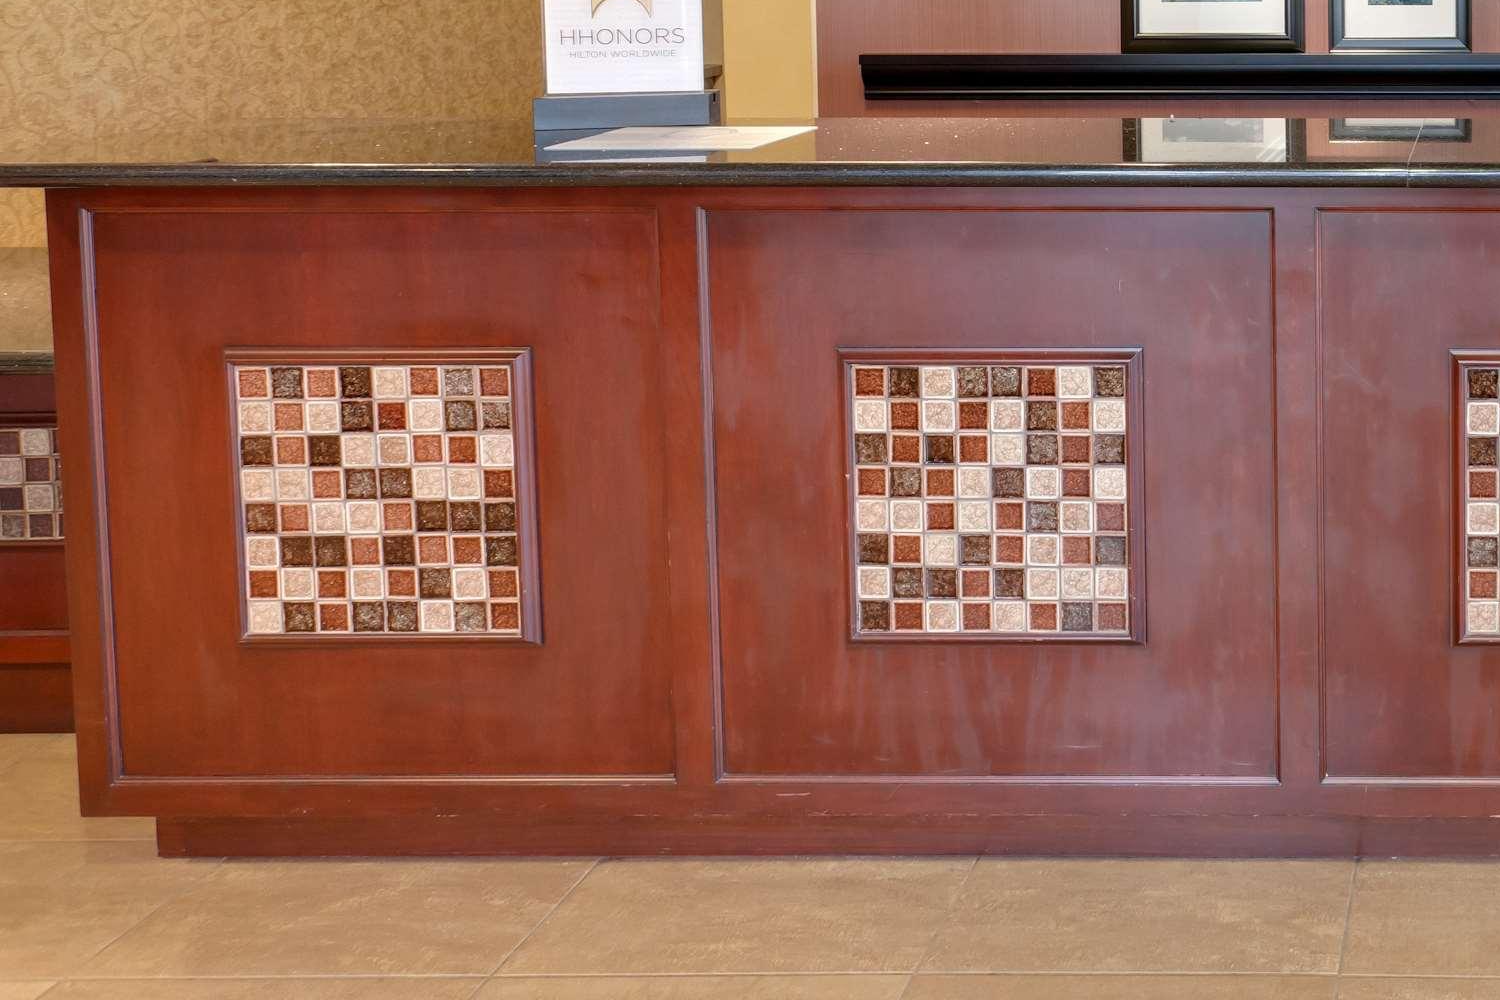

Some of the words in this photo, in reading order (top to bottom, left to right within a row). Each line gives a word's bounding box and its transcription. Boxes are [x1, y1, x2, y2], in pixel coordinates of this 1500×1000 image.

[560, 27, 685, 45] HHONORS
[569, 50, 607, 59] HILTON
[610, 50, 677, 59] WORLDWIDE
